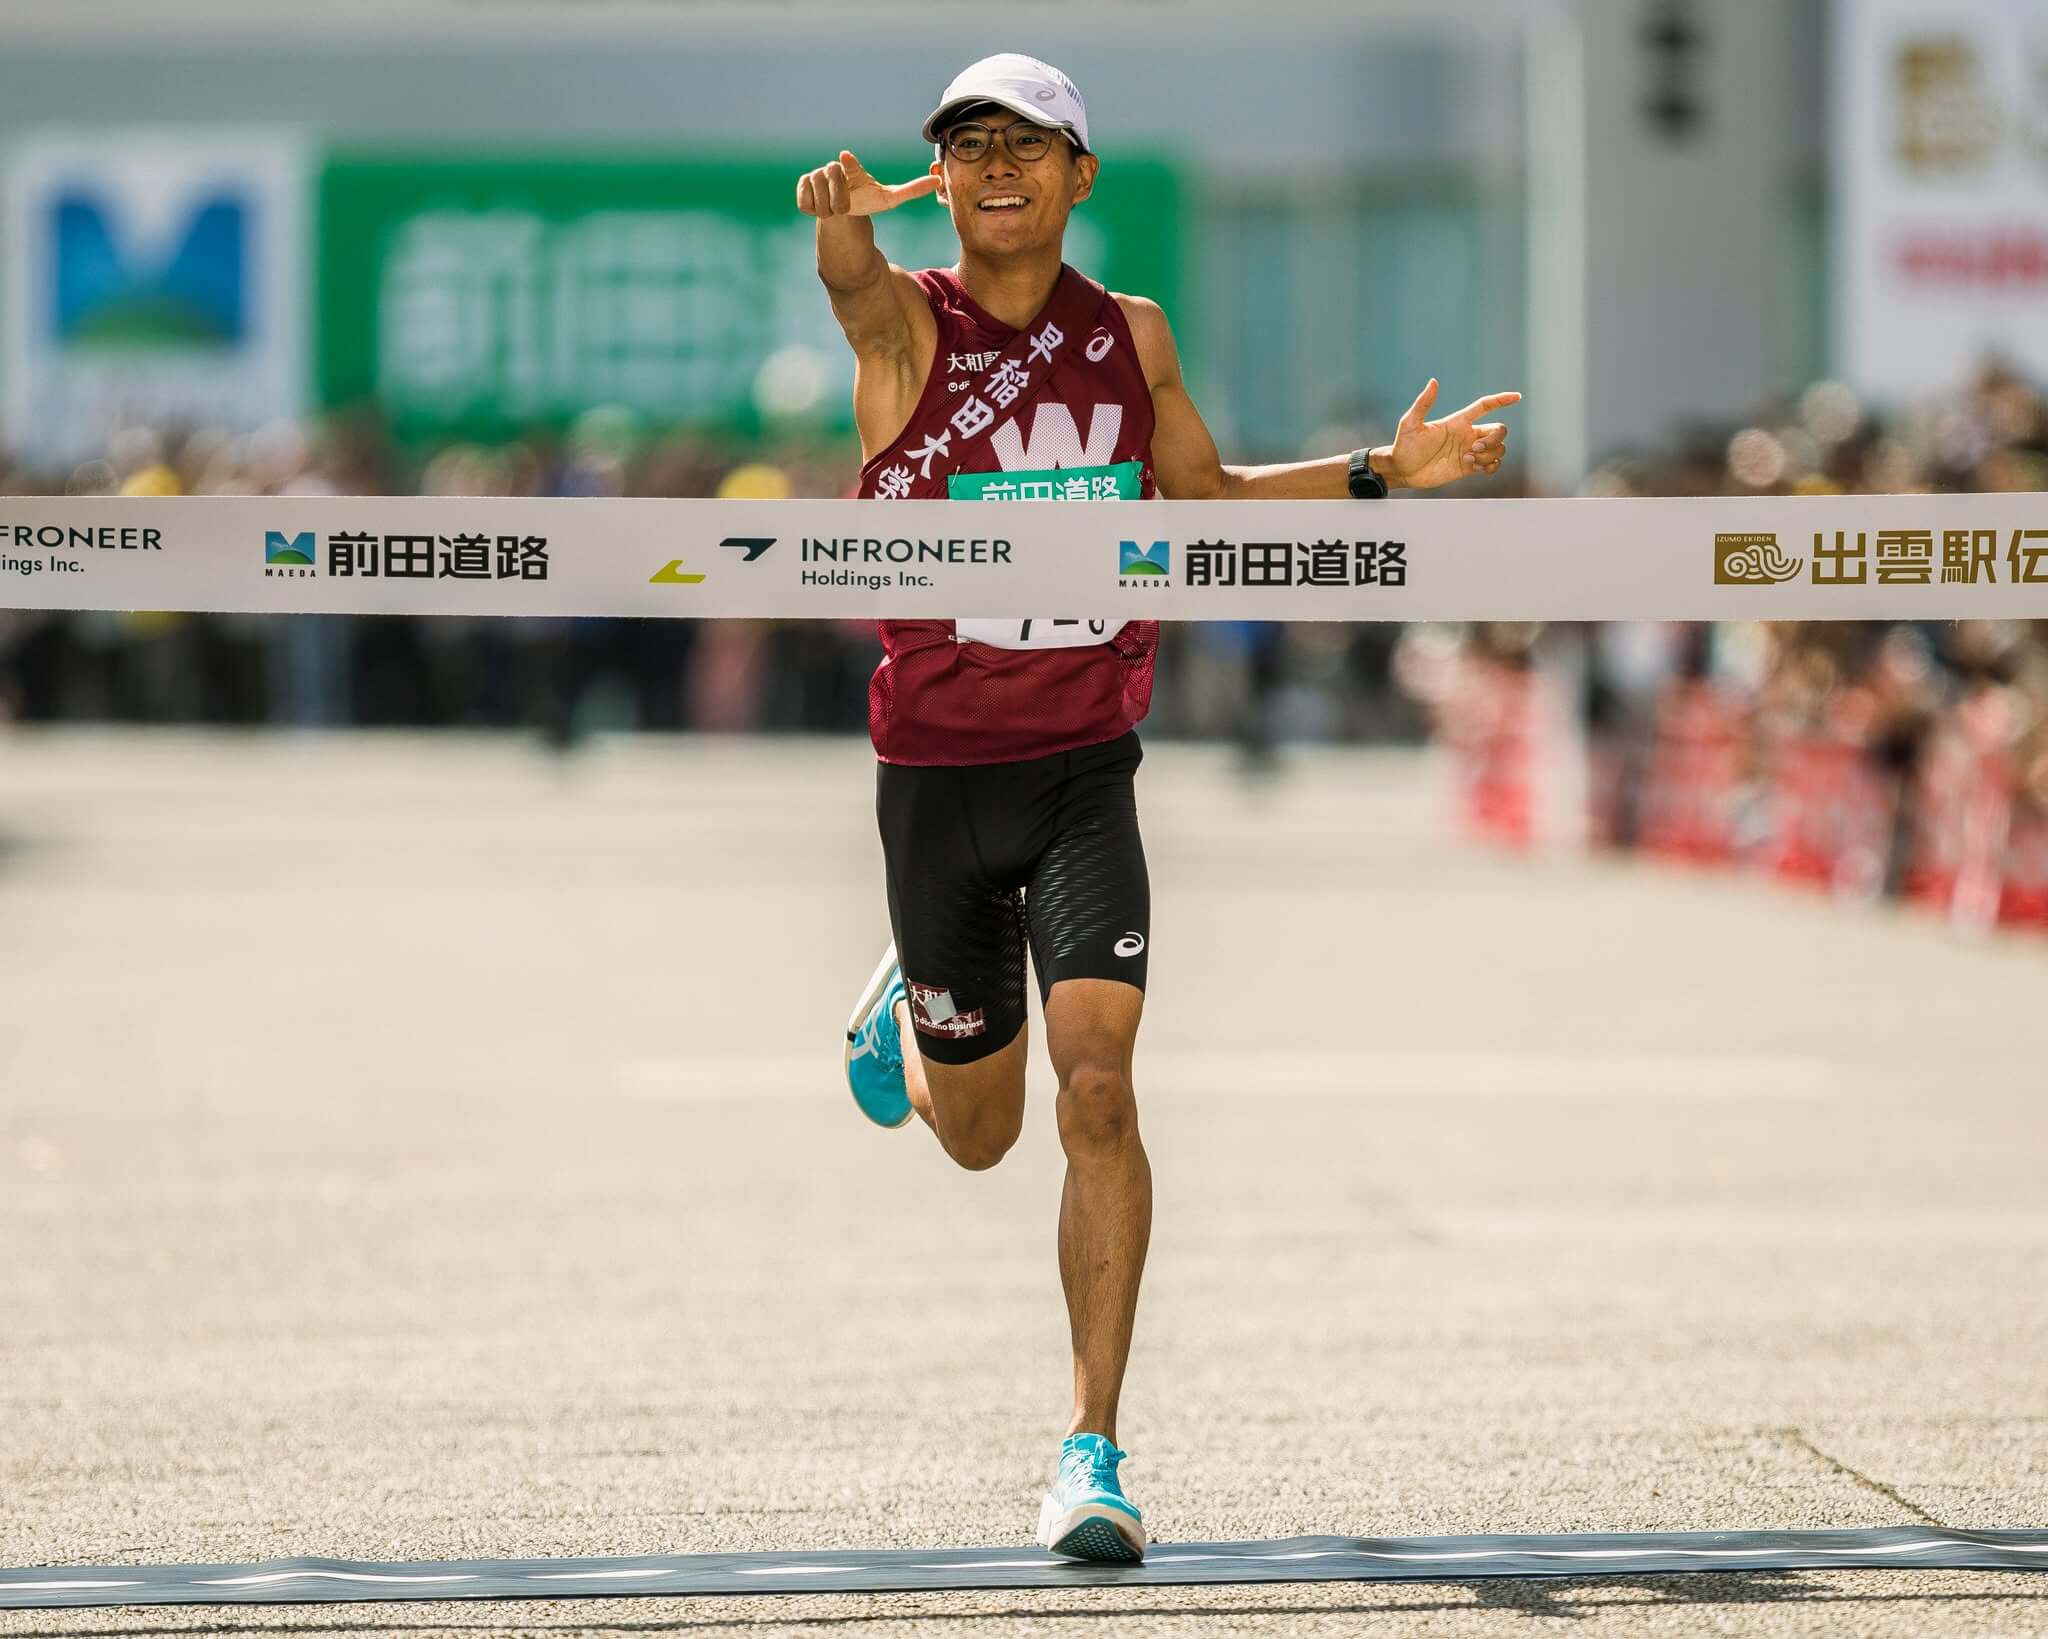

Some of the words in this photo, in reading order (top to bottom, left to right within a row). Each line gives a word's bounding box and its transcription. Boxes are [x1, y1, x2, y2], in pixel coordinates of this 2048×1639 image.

[990, 402, 1123, 473] W
[802, 538, 1012, 563] INFRONEER
[1716, 535, 1742, 543] IZUMO
[1743, 535, 1772, 543] EKIDEN
[1, 554, 43, 575] ings
[50, 556, 85, 572] Inc.
[327, 531, 549, 580] 前田道路
[1186, 539, 1407, 586] 前田道路
[1811, 529, 2048, 584] 出雲駅伝
[265, 568, 316, 578] MAEDA
[802, 569, 892, 590] Holdings
[899, 571, 934, 586] Inc.
[1119, 579, 1170, 588] MAEDA
